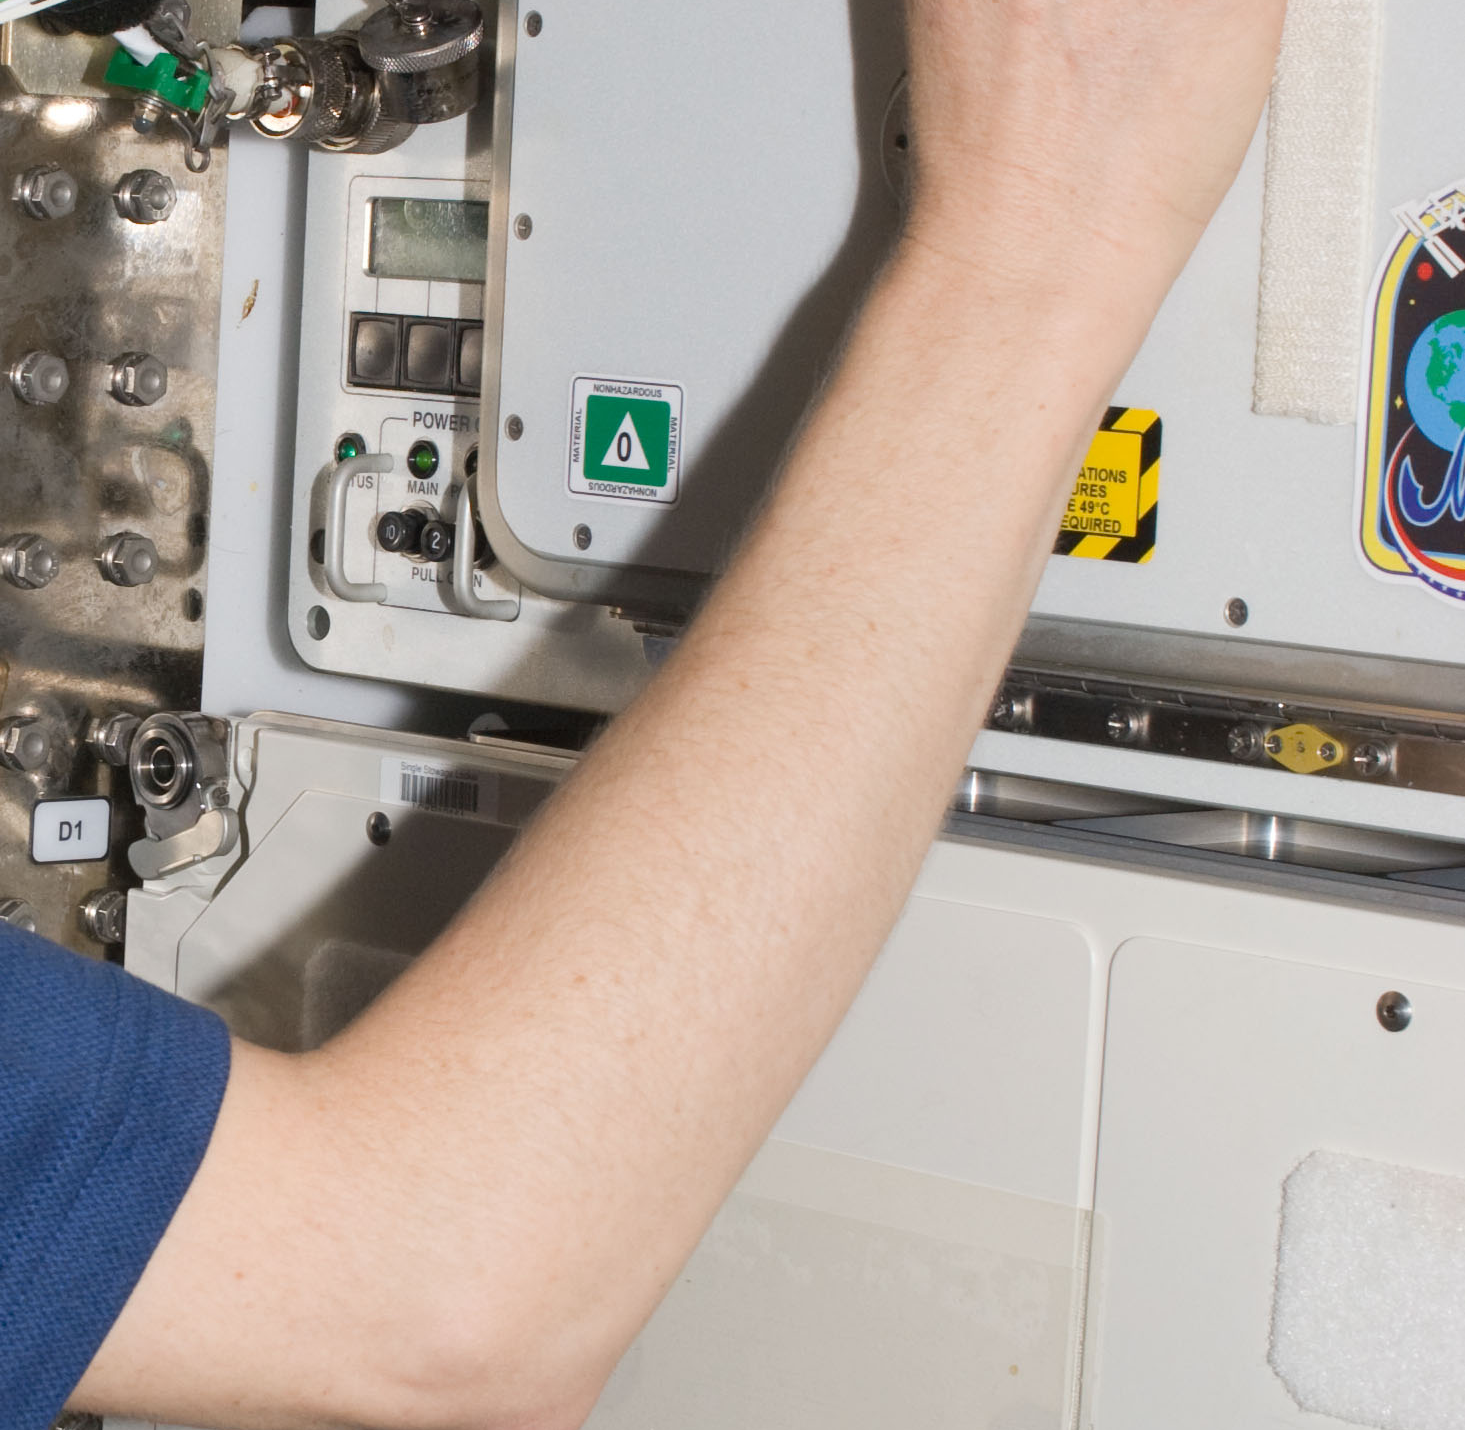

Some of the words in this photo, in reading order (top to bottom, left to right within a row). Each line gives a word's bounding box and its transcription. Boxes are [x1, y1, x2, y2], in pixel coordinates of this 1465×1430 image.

[592, 382, 663, 399] NONHAZARDOUS
[412, 410, 470, 433] POWER
[572, 407, 583, 463] MATERIAL
[667, 416, 679, 473] MATERIAL
[616, 431, 632, 463] 0
[1078, 466, 1128, 484] ATIONS
[406, 479, 439, 496] MAIN
[588, 481, 658, 498] NONHAZARDOUS
[1071, 482, 1108, 499] URES
[1079, 501, 1110, 516] 49°C
[1061, 514, 1122, 534] EQUIRED
[431, 530, 442, 550] 2
[411, 566, 444, 584] PULL
[58, 819, 83, 842] D1
